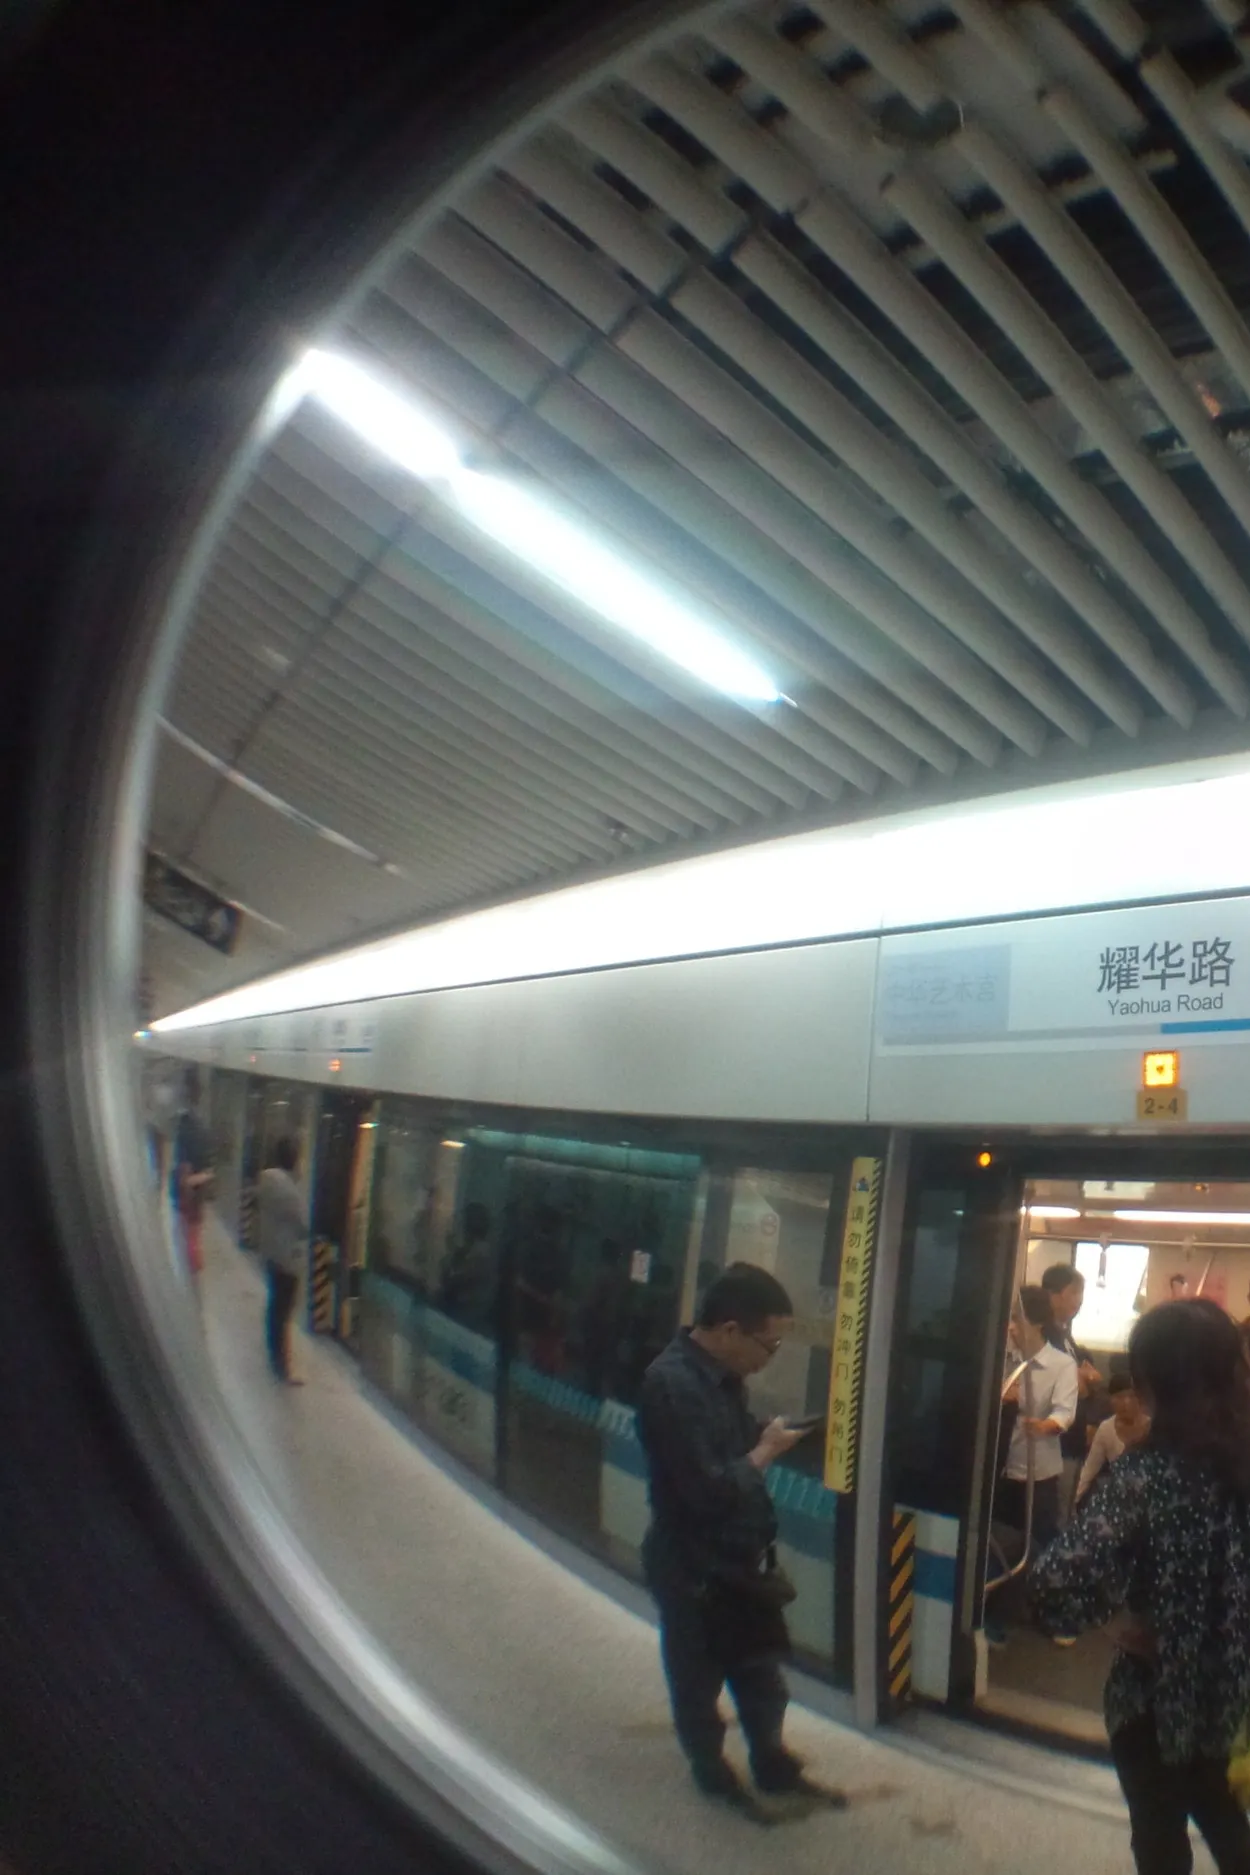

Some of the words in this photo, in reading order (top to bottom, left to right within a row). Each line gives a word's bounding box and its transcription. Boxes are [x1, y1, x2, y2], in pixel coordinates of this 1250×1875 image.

[1097, 937, 1235, 994] 耀华路
[1108, 997, 1171, 1016] Yaohua
[1177, 992, 1224, 1012] Road
[1144, 1097, 1179, 1115] 2-4
